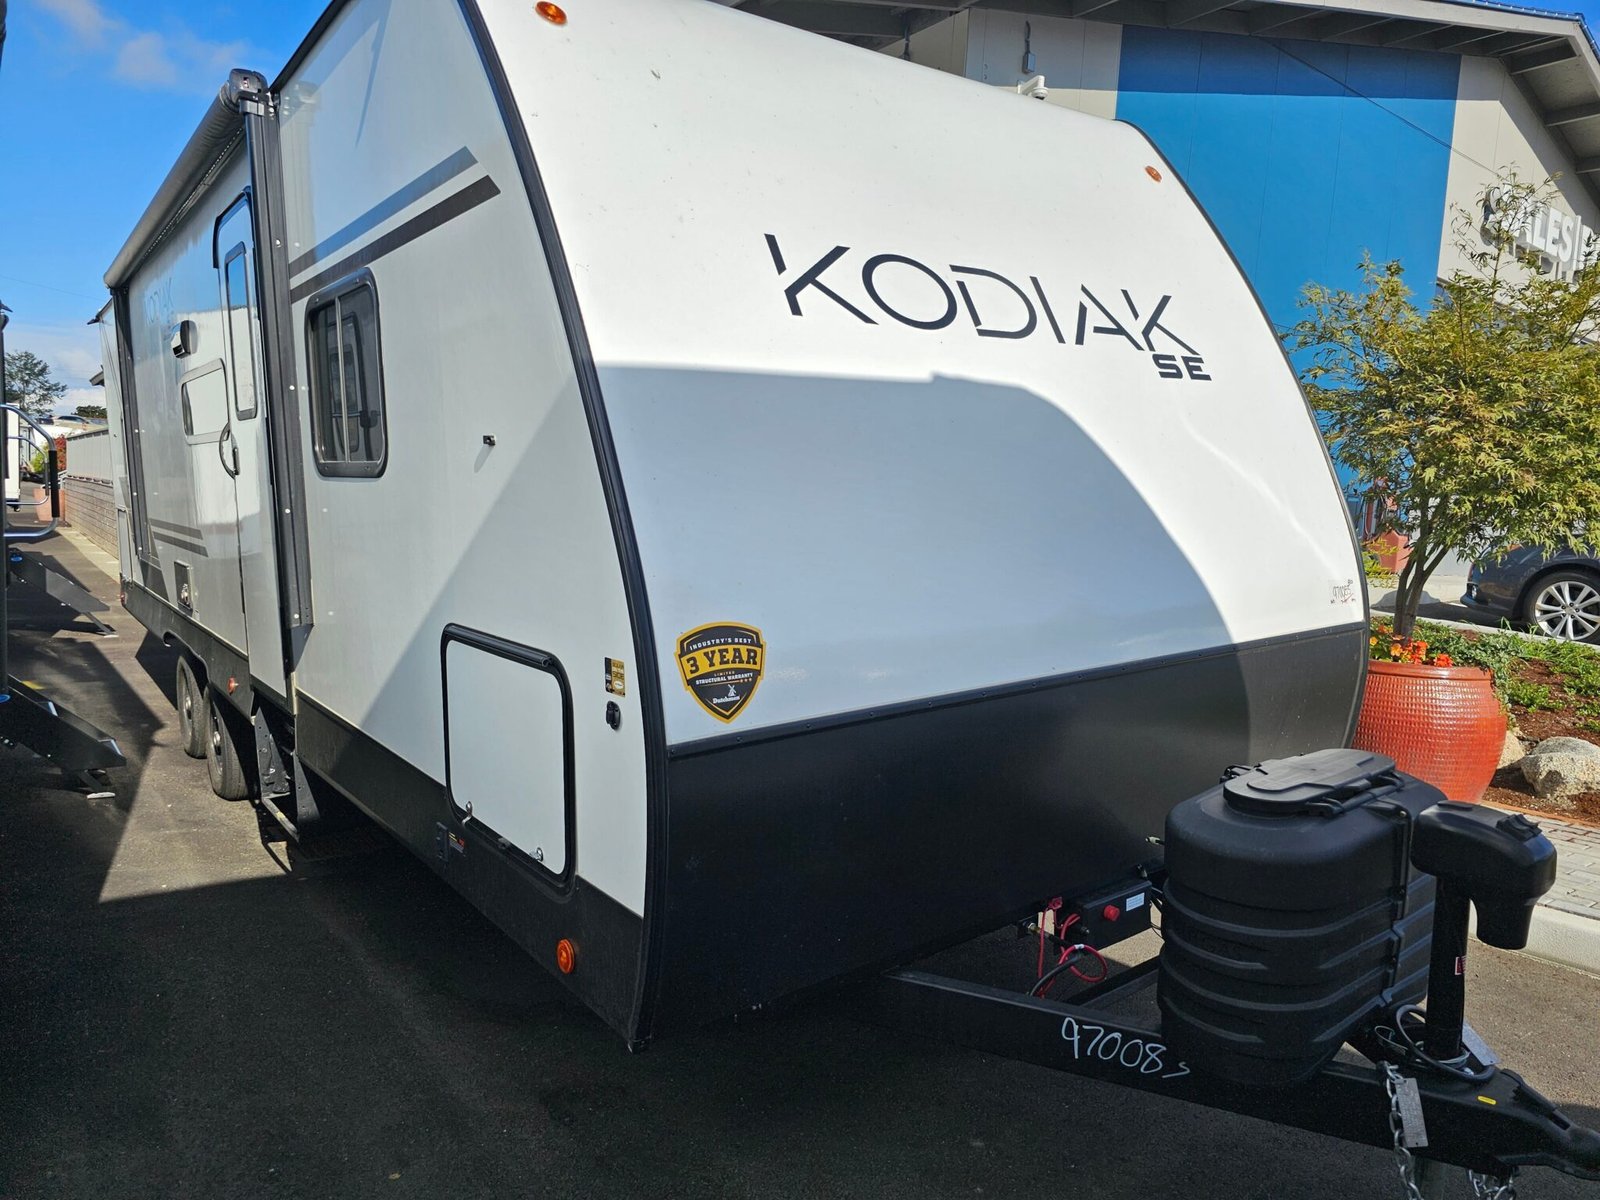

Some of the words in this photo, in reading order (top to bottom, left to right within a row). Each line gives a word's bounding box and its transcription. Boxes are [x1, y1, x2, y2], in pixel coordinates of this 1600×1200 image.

[764, 233, 1200, 356] KODIAK
[1152, 354, 1212, 381] SE
[686, 656, 700, 674] 3
[703, 647, 758, 667] YEAR
[695, 676, 727, 685] STRUCTURAL
[728, 672, 753, 681] WARRANTY
